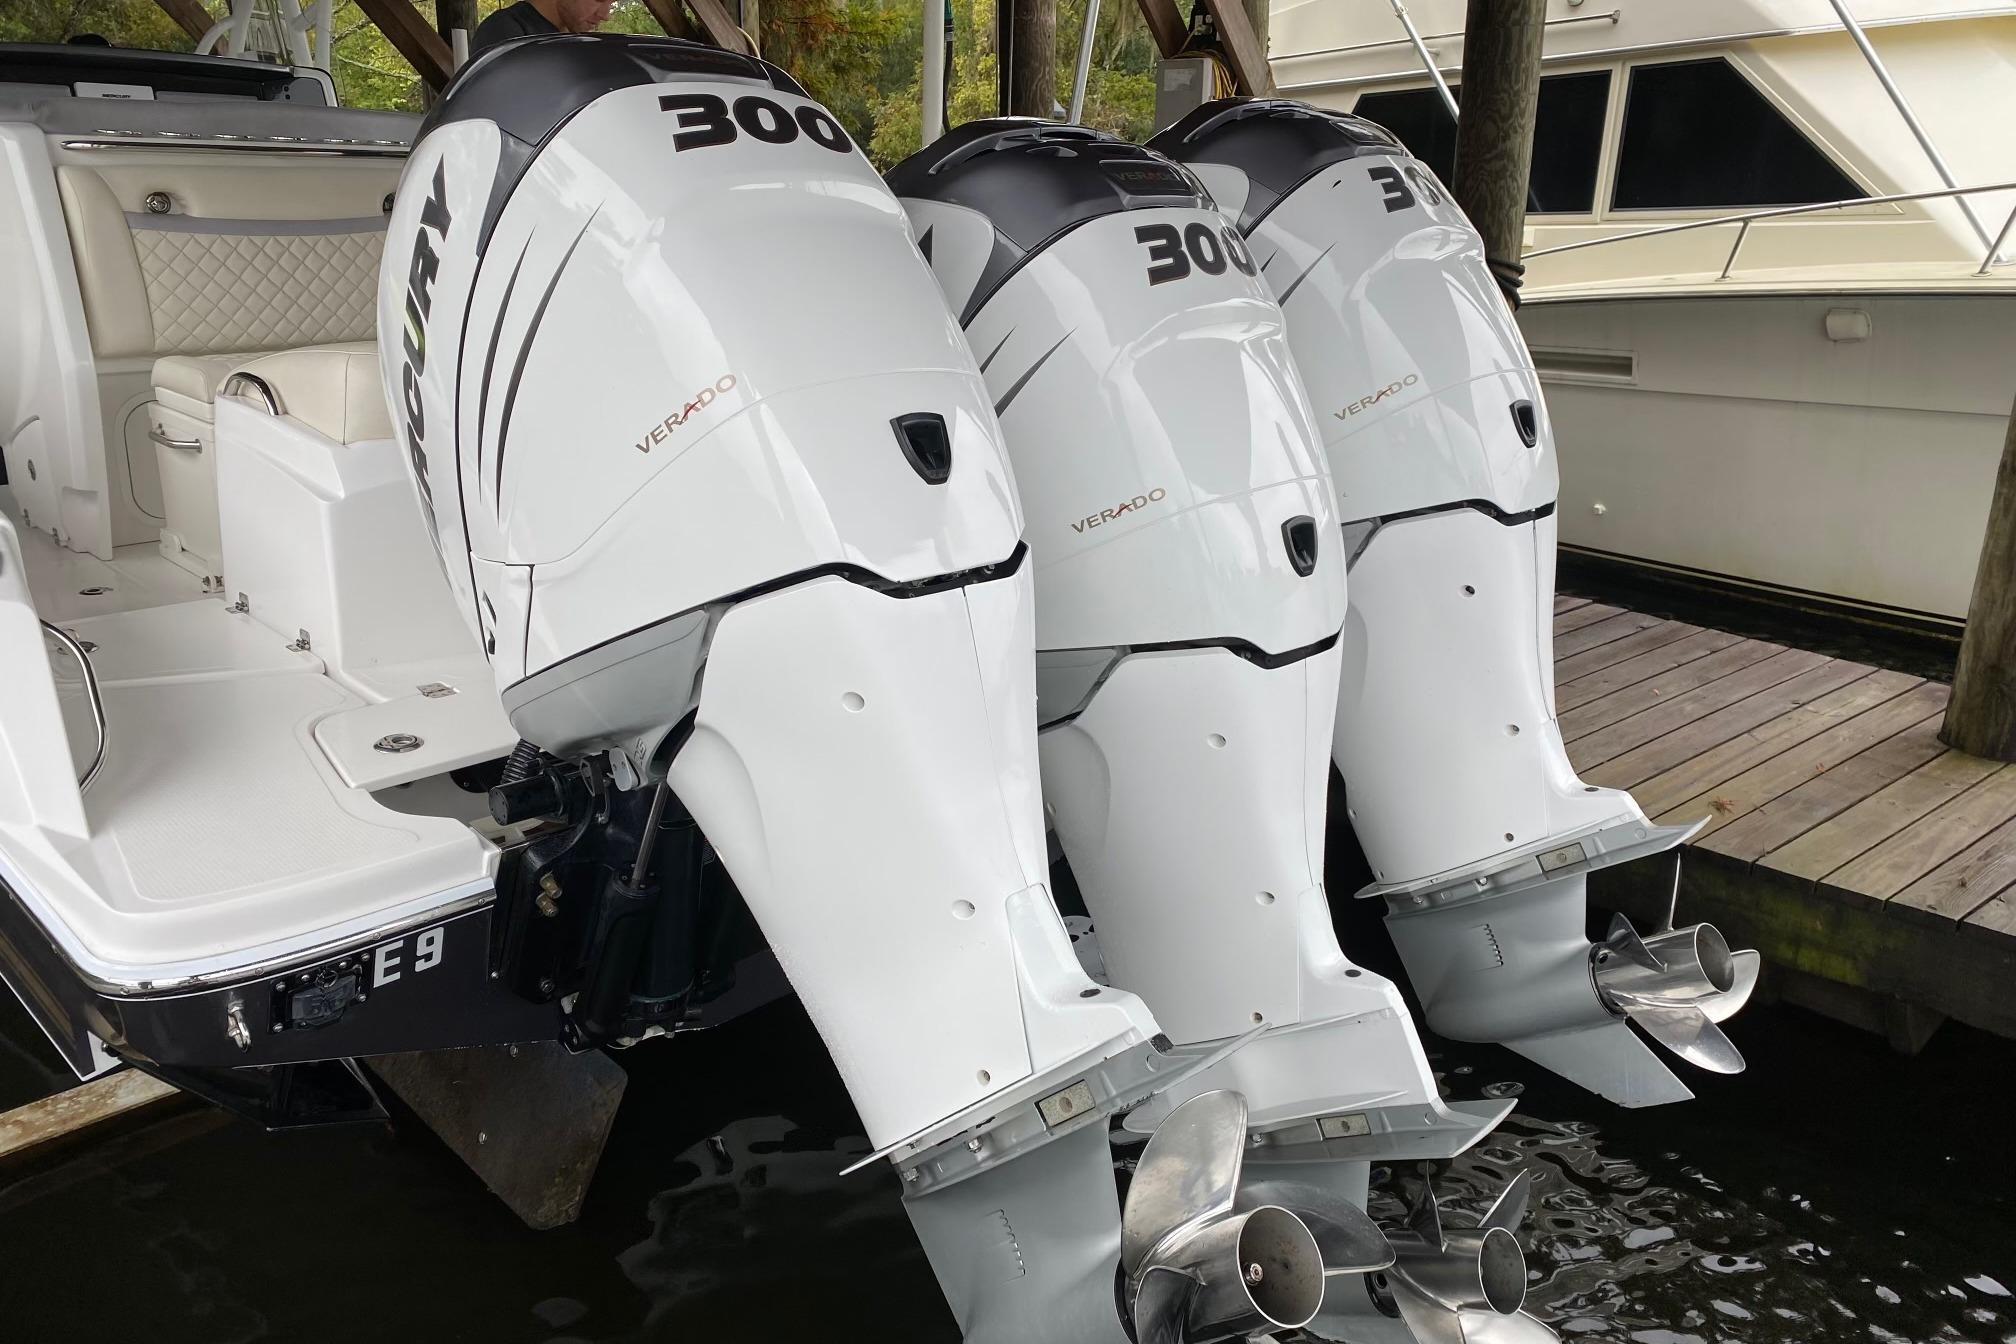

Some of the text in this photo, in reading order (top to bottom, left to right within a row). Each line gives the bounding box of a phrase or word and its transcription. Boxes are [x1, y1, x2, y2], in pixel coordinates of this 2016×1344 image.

[658, 93, 852, 153] 300
[1367, 166, 1457, 214] 30
[1133, 222, 1258, 287] 300
[403, 153, 453, 592] RCURY
[1333, 373, 1419, 421] VERADO
[635, 374, 737, 454] VERADO
[1071, 487, 1166, 534] VERADO
